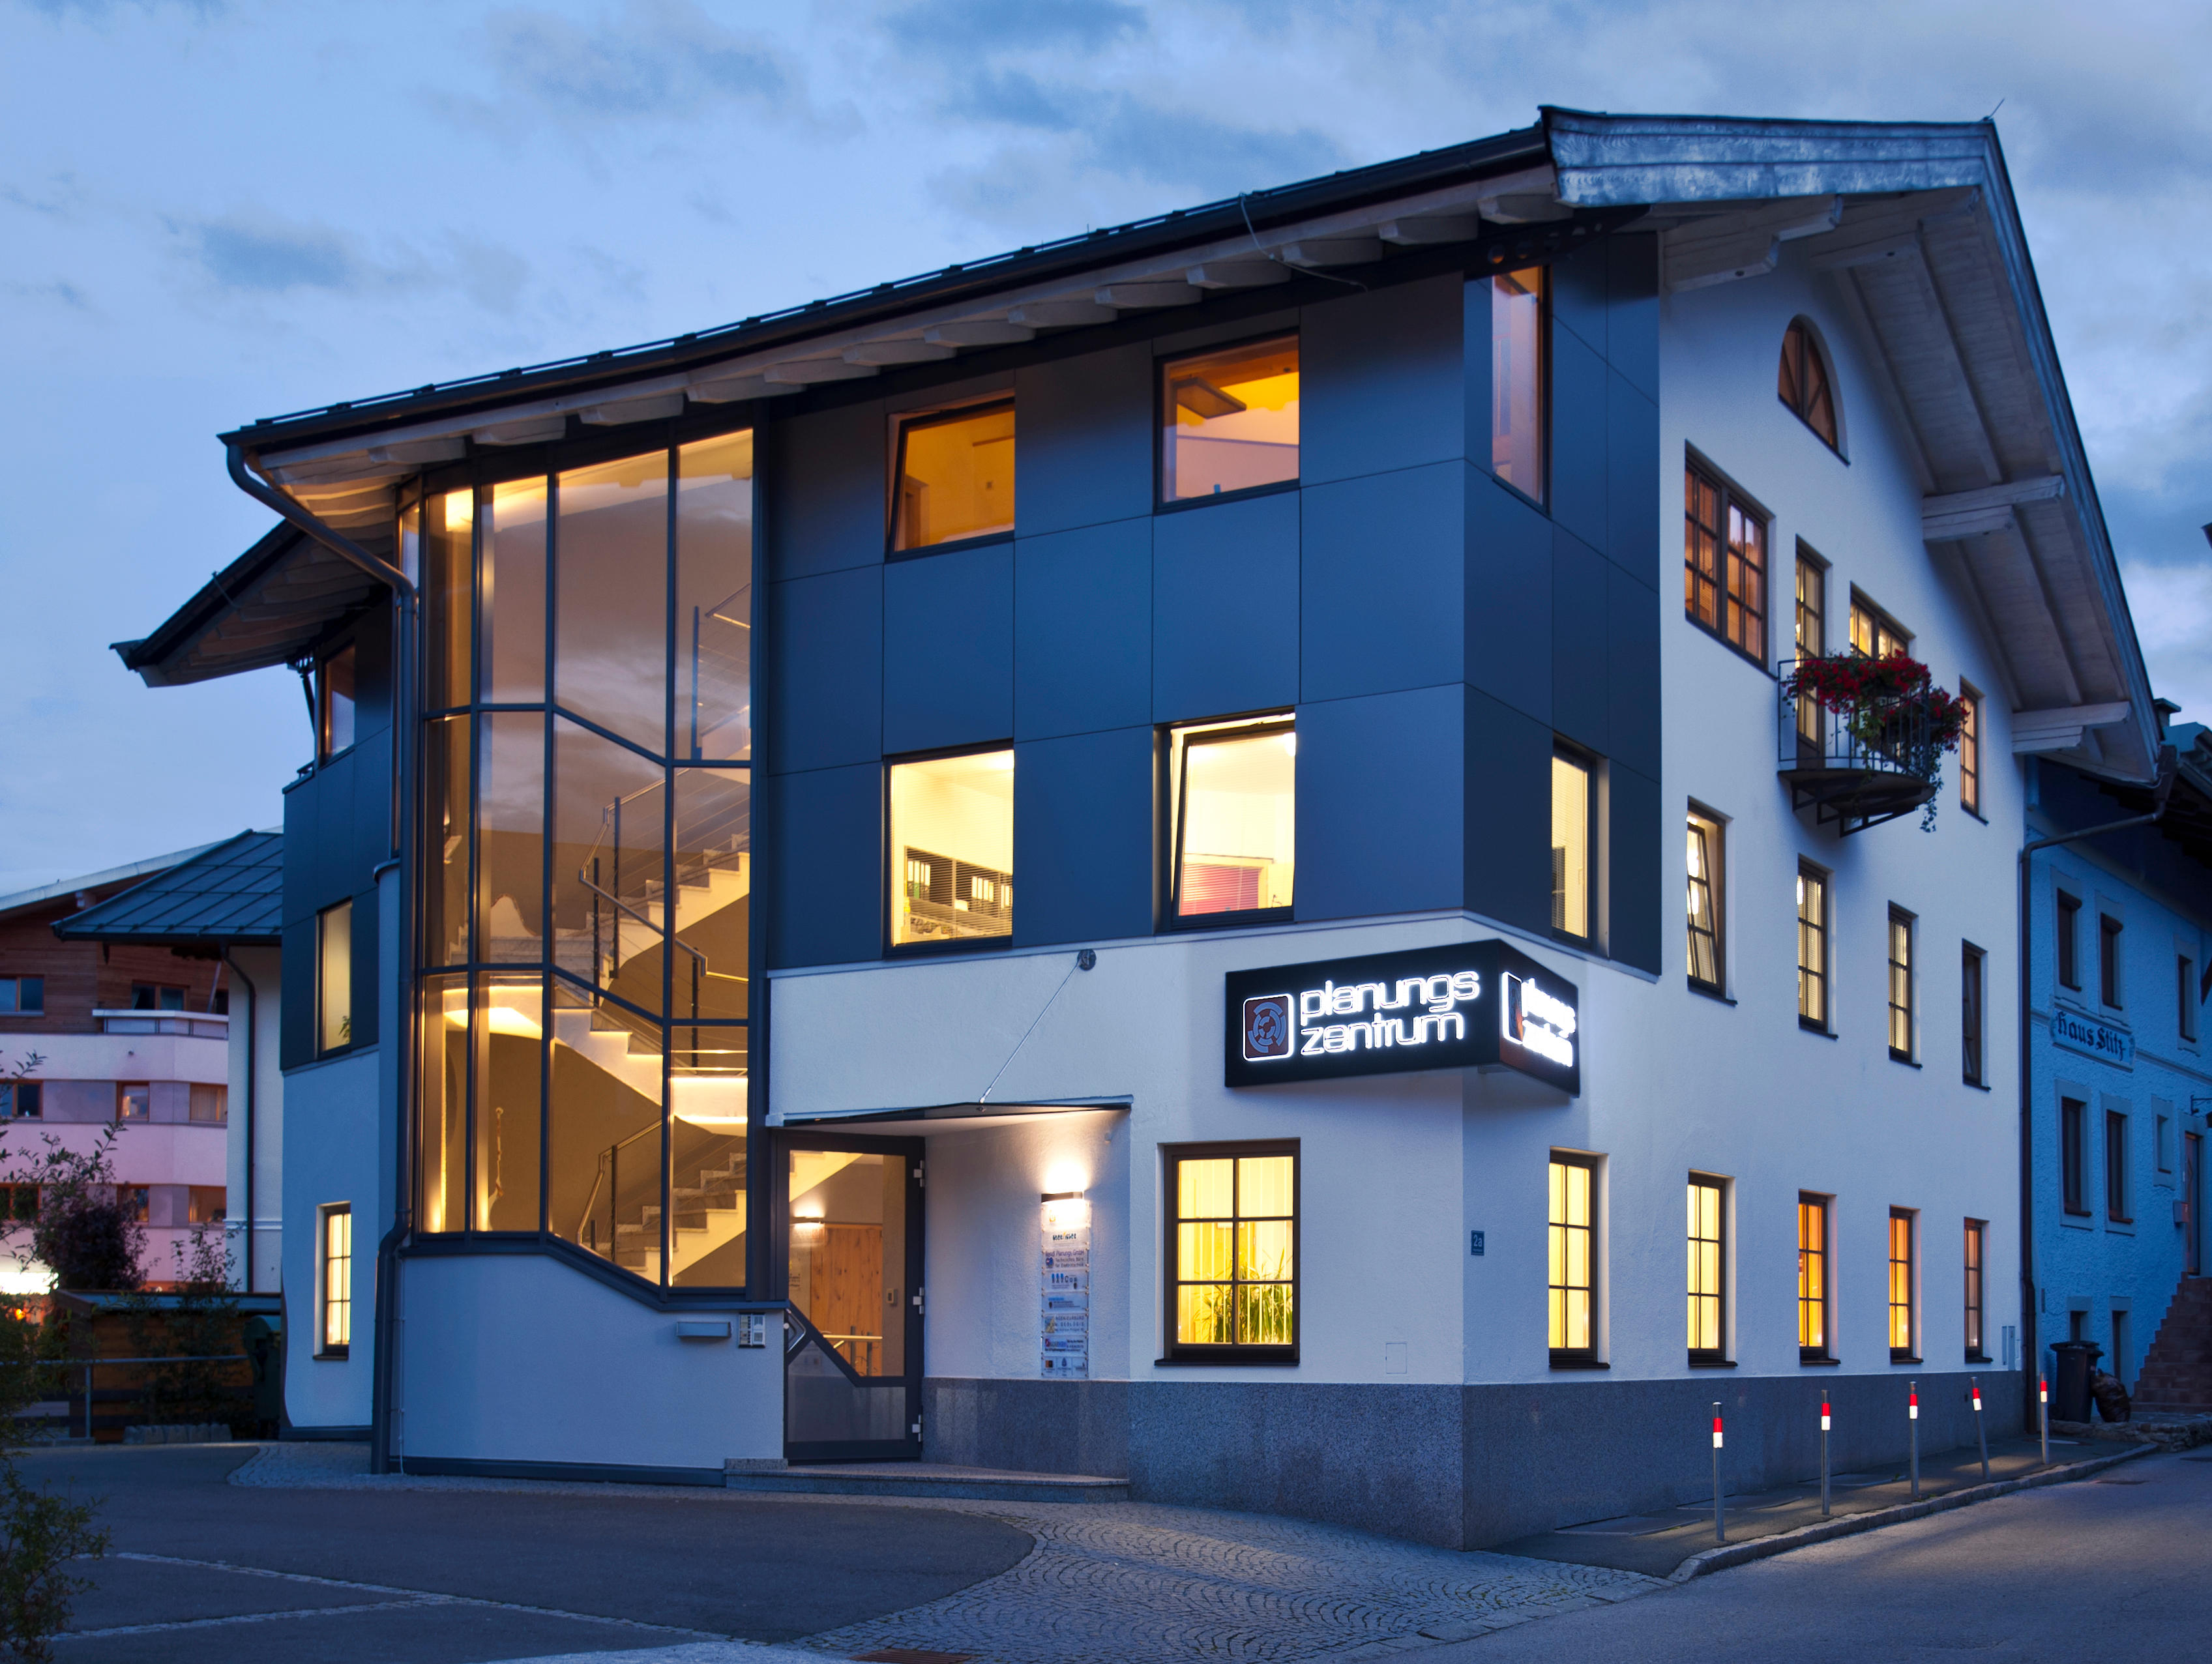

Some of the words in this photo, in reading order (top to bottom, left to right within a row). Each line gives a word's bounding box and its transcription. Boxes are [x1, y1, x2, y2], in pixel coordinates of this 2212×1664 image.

[1300, 971, 1480, 1026] planungs
[1300, 1012, 1464, 1057] zentrum
[2057, 1011, 2094, 1047] Haus
[1473, 1234, 1482, 1247] 2a
